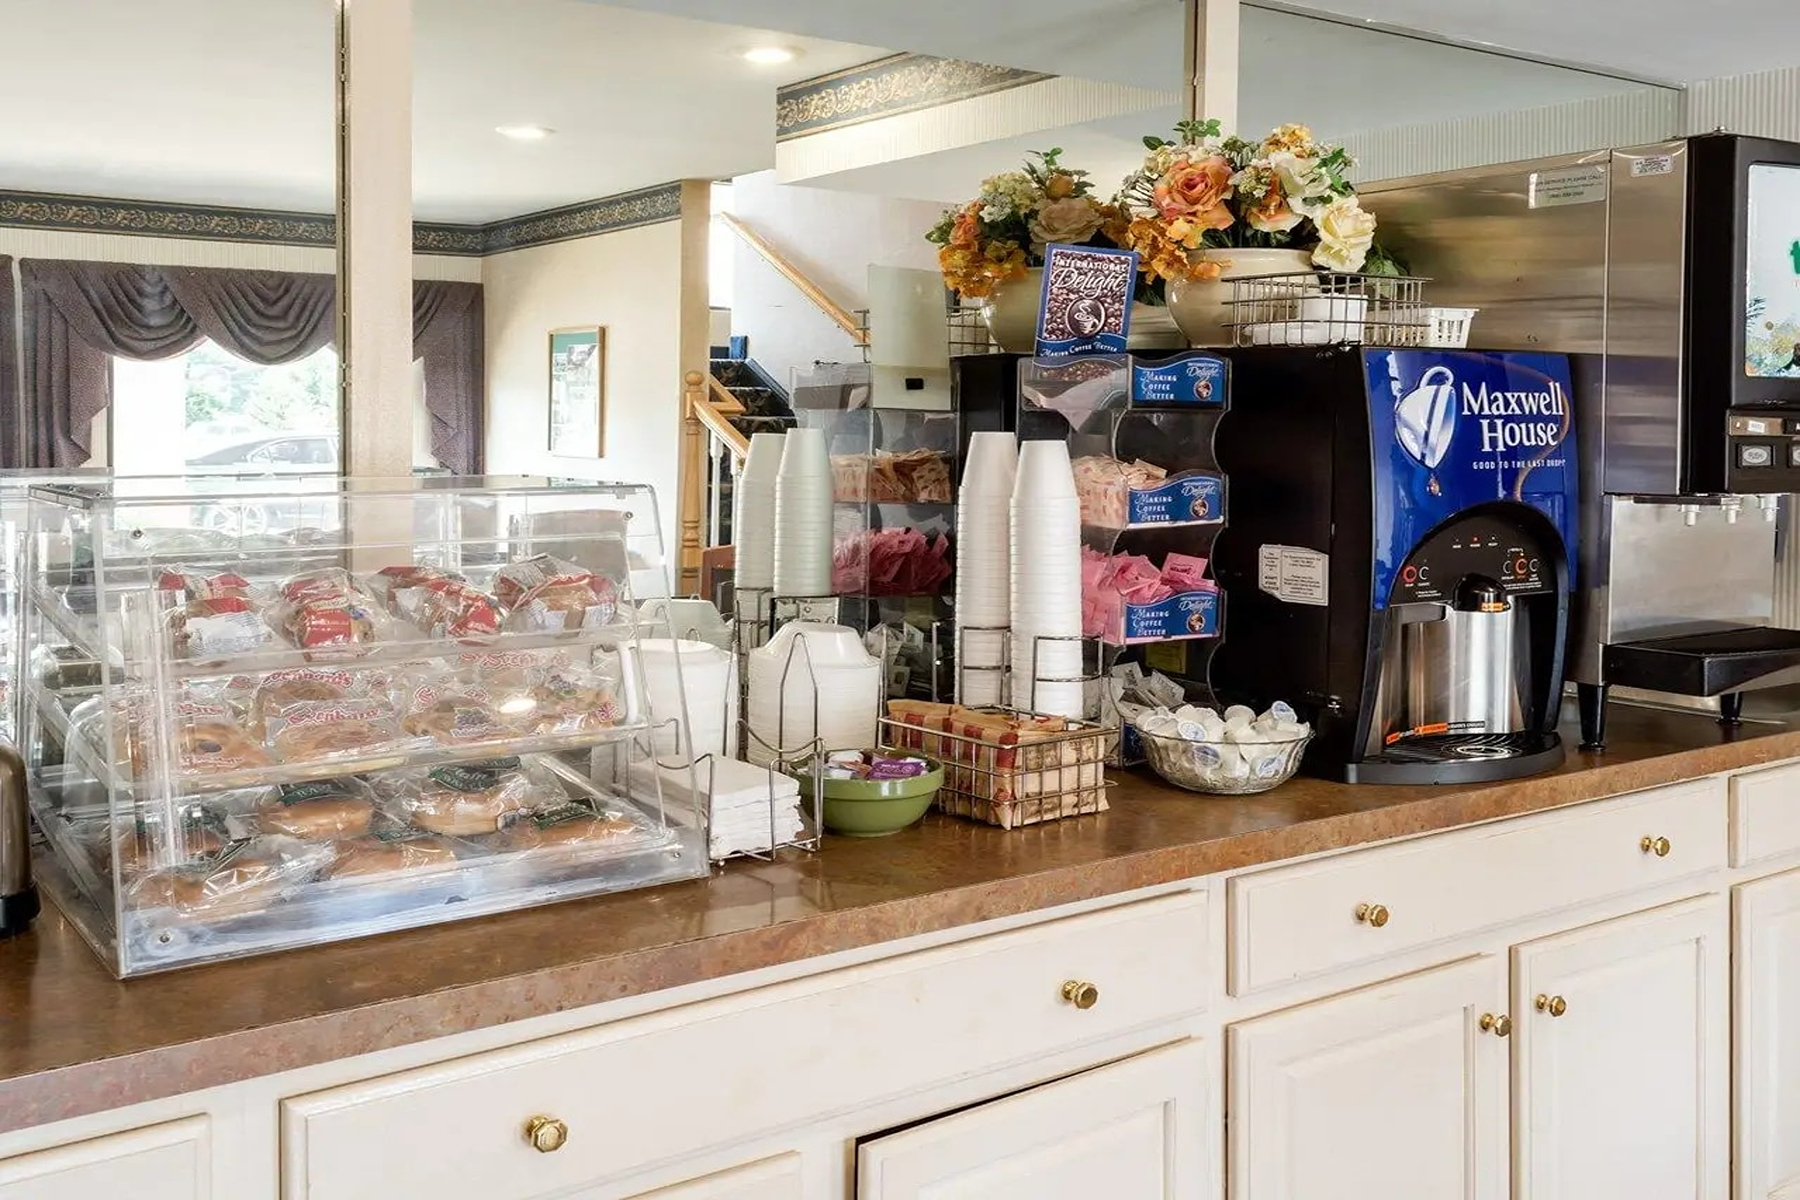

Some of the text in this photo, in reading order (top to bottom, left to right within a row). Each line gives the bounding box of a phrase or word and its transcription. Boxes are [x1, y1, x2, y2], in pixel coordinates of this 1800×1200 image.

[1055, 255, 1128, 272] INTERNATIONAL
[1051, 266, 1131, 299] Delight
[1462, 381, 1564, 416] Maxwell
[1479, 418, 1558, 452] House
[1472, 461, 1496, 470] GOOD
[1499, 461, 1509, 470] TO
